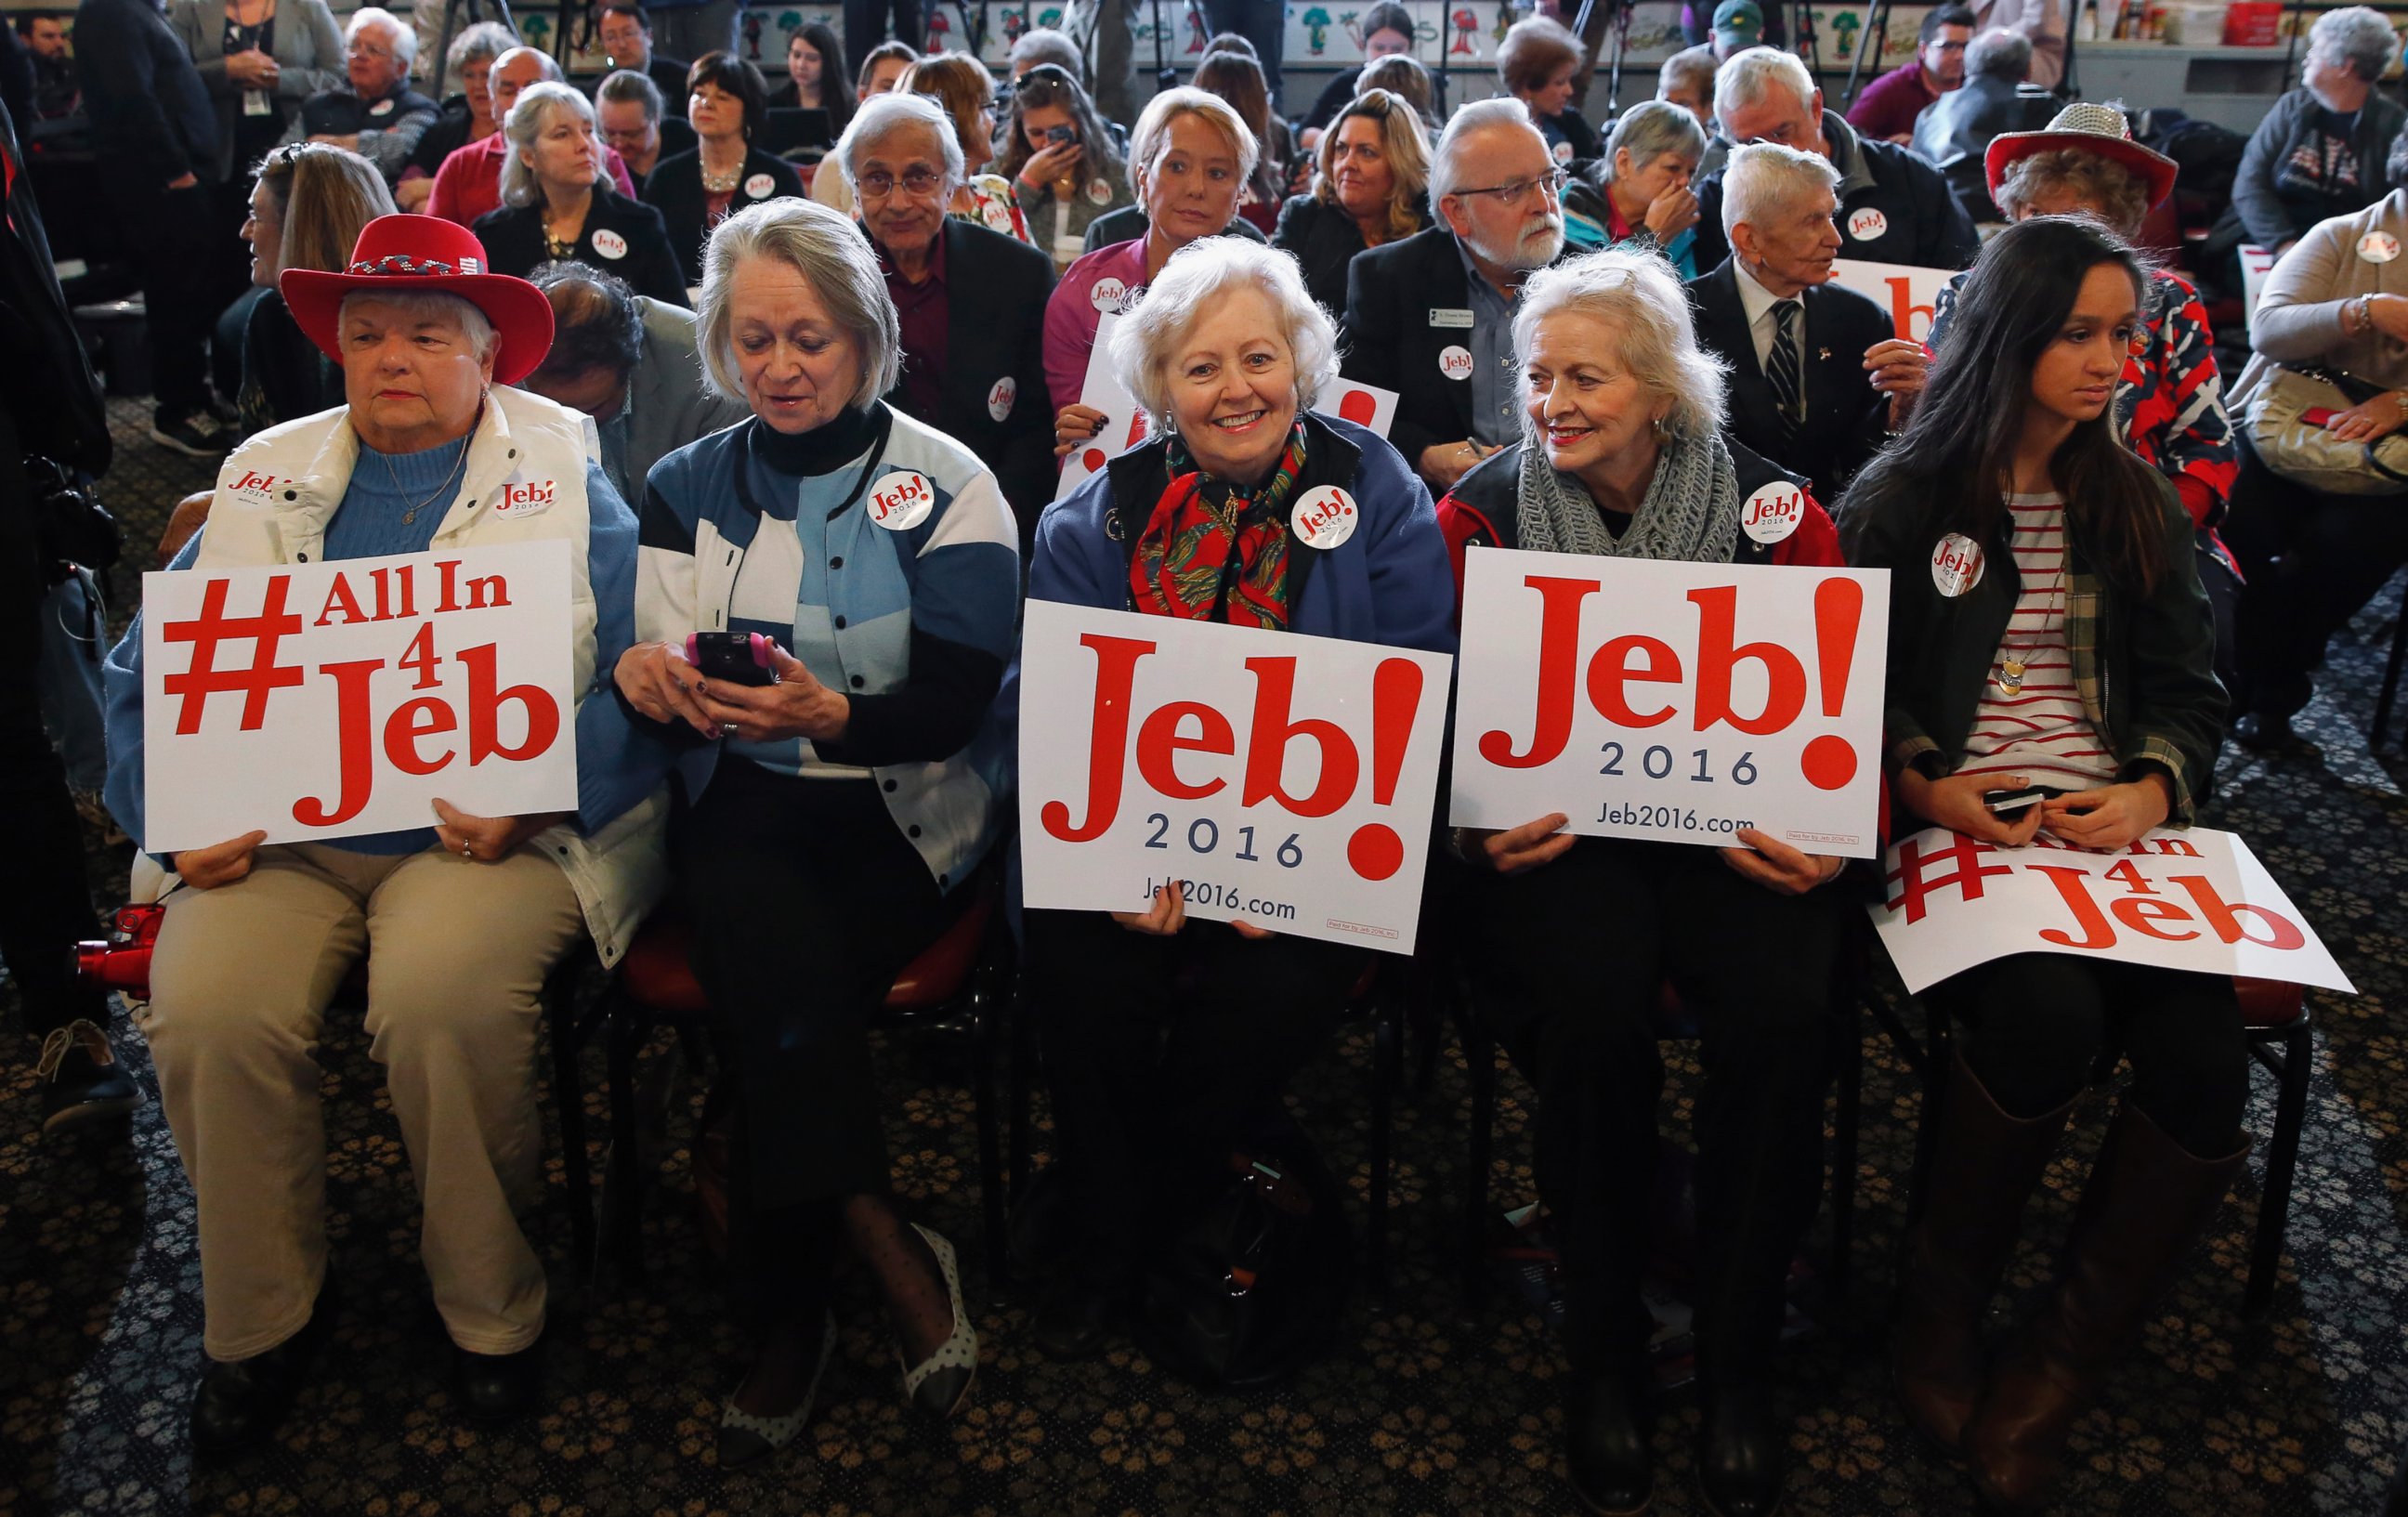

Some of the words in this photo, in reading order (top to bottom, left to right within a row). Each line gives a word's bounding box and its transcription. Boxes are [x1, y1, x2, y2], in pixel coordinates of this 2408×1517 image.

[1444, 354, 1472, 372] Jeb!
[496, 480, 555, 510] Jeb!
[872, 475, 929, 520] Jeb!
[893, 502, 917, 514] 2016
[1300, 489, 1353, 542] Jeb!
[1744, 492, 1799, 526] Jeb!
[434, 559, 513, 612] In
[399, 621, 443, 689] 4
[1478, 574, 1865, 791] Jeb!
[293, 643, 559, 827] Jeb
[1040, 633, 1424, 882] Jeb!
[1599, 741, 1758, 786] 2016
[1145, 813, 1302, 869] 2016
[1143, 876, 1296, 921] Je2016.com
[2103, 858, 2162, 895] 4
[2024, 864, 2305, 950] Jeb
